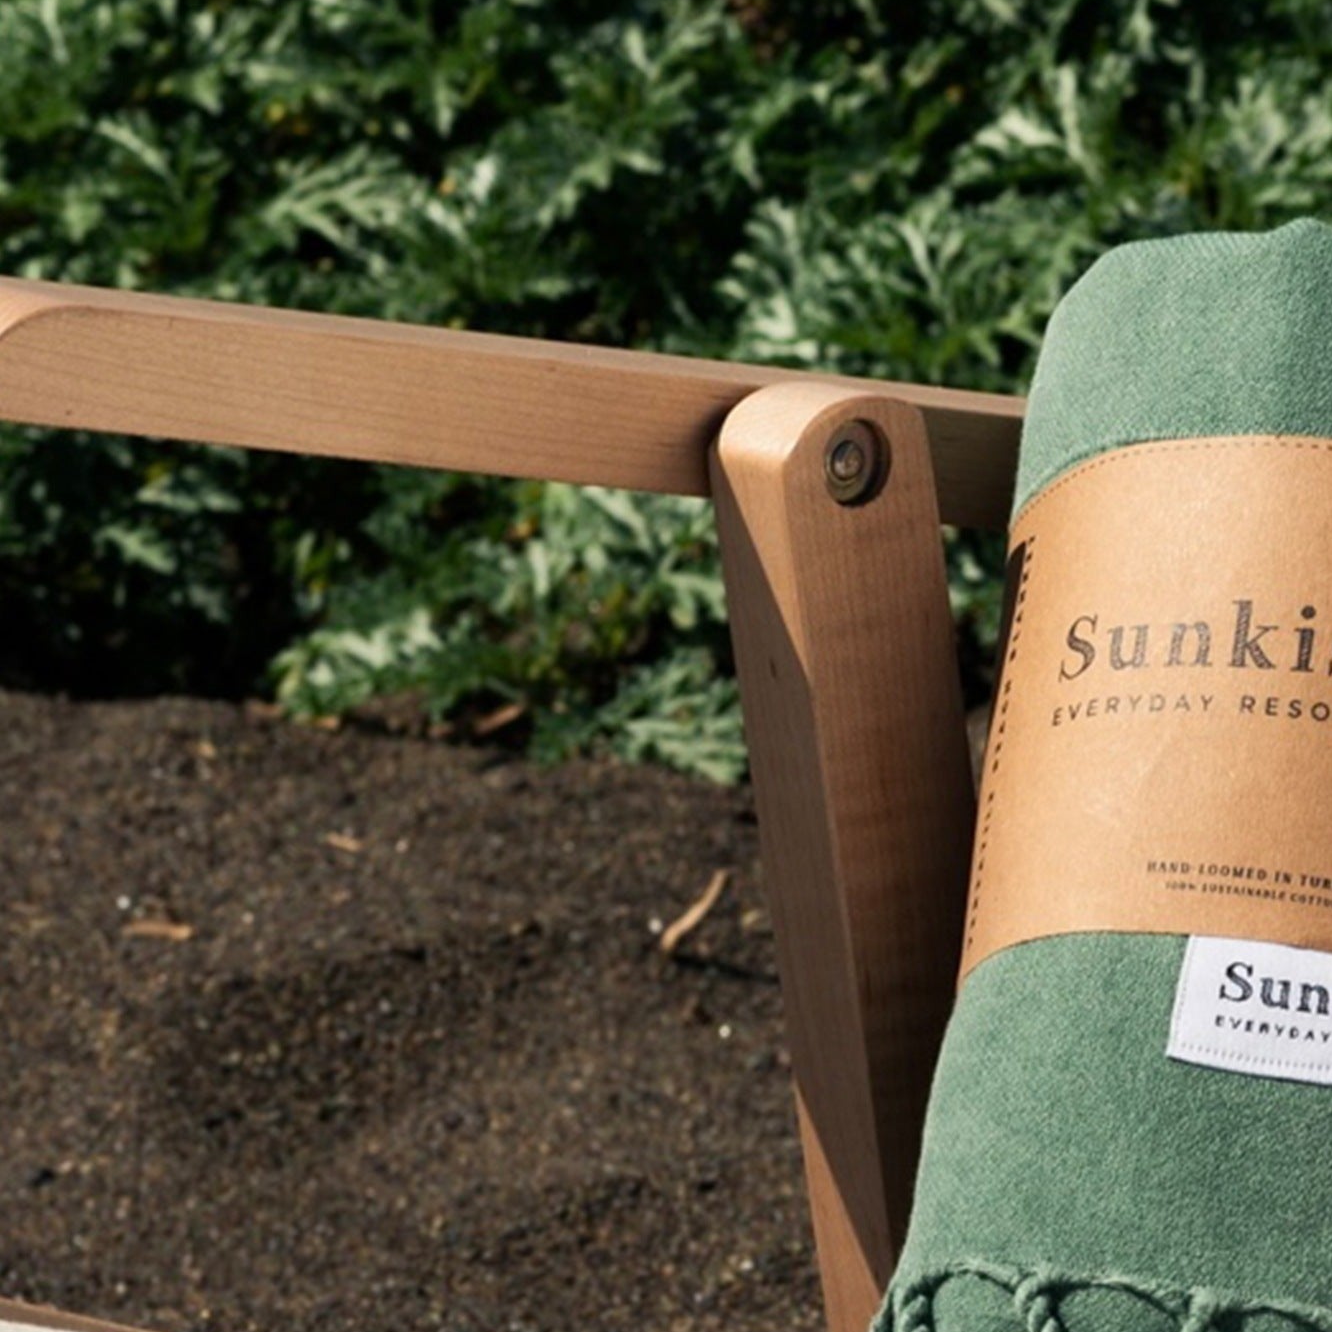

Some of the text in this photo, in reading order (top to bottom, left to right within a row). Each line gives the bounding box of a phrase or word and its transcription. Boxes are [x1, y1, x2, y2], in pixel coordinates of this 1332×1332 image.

[1051, 694, 1214, 727] EVERYDAY
[1274, 871, 1292, 884] IN
[1215, 1014, 1332, 1043] EVERYDAY
